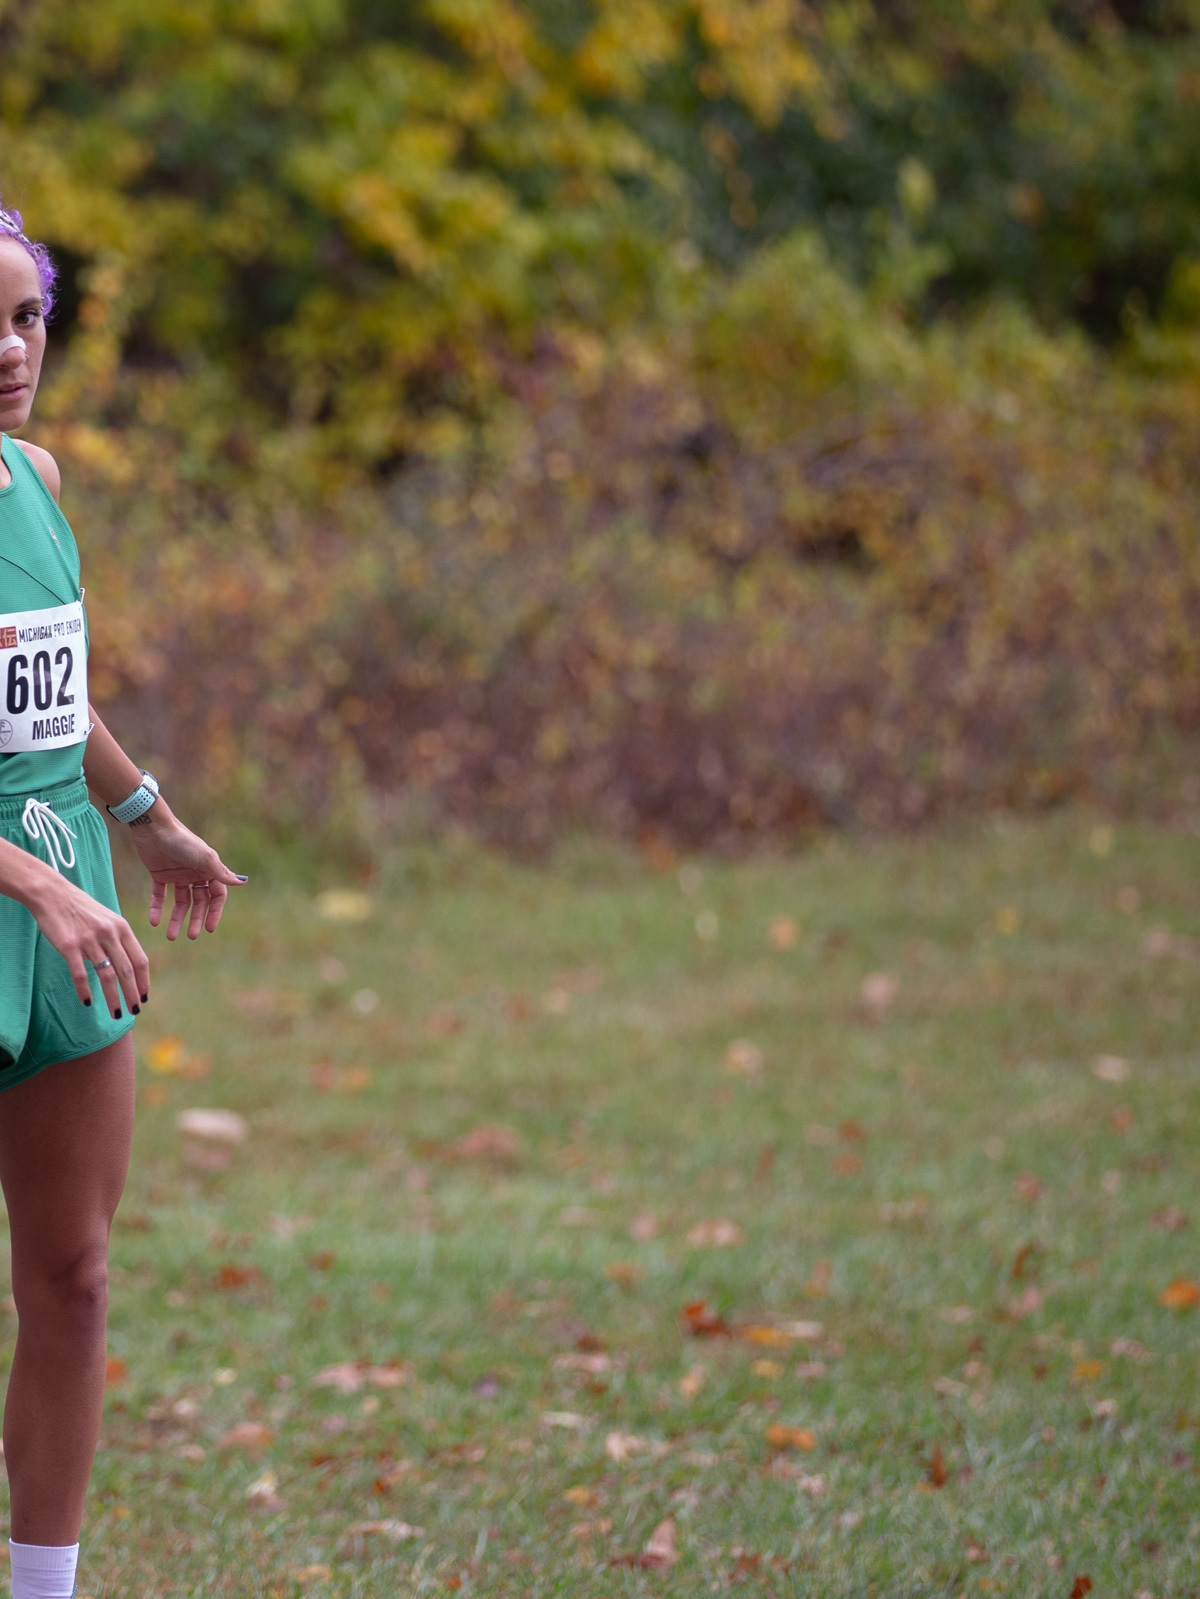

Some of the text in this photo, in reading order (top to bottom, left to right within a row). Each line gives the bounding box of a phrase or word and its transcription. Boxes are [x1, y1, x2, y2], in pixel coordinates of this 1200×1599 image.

[18, 617, 82, 643] MICHIGAN PRO EKIDEN
[6, 646, 75, 715] 602
[32, 713, 75, 741] MAGGIE
